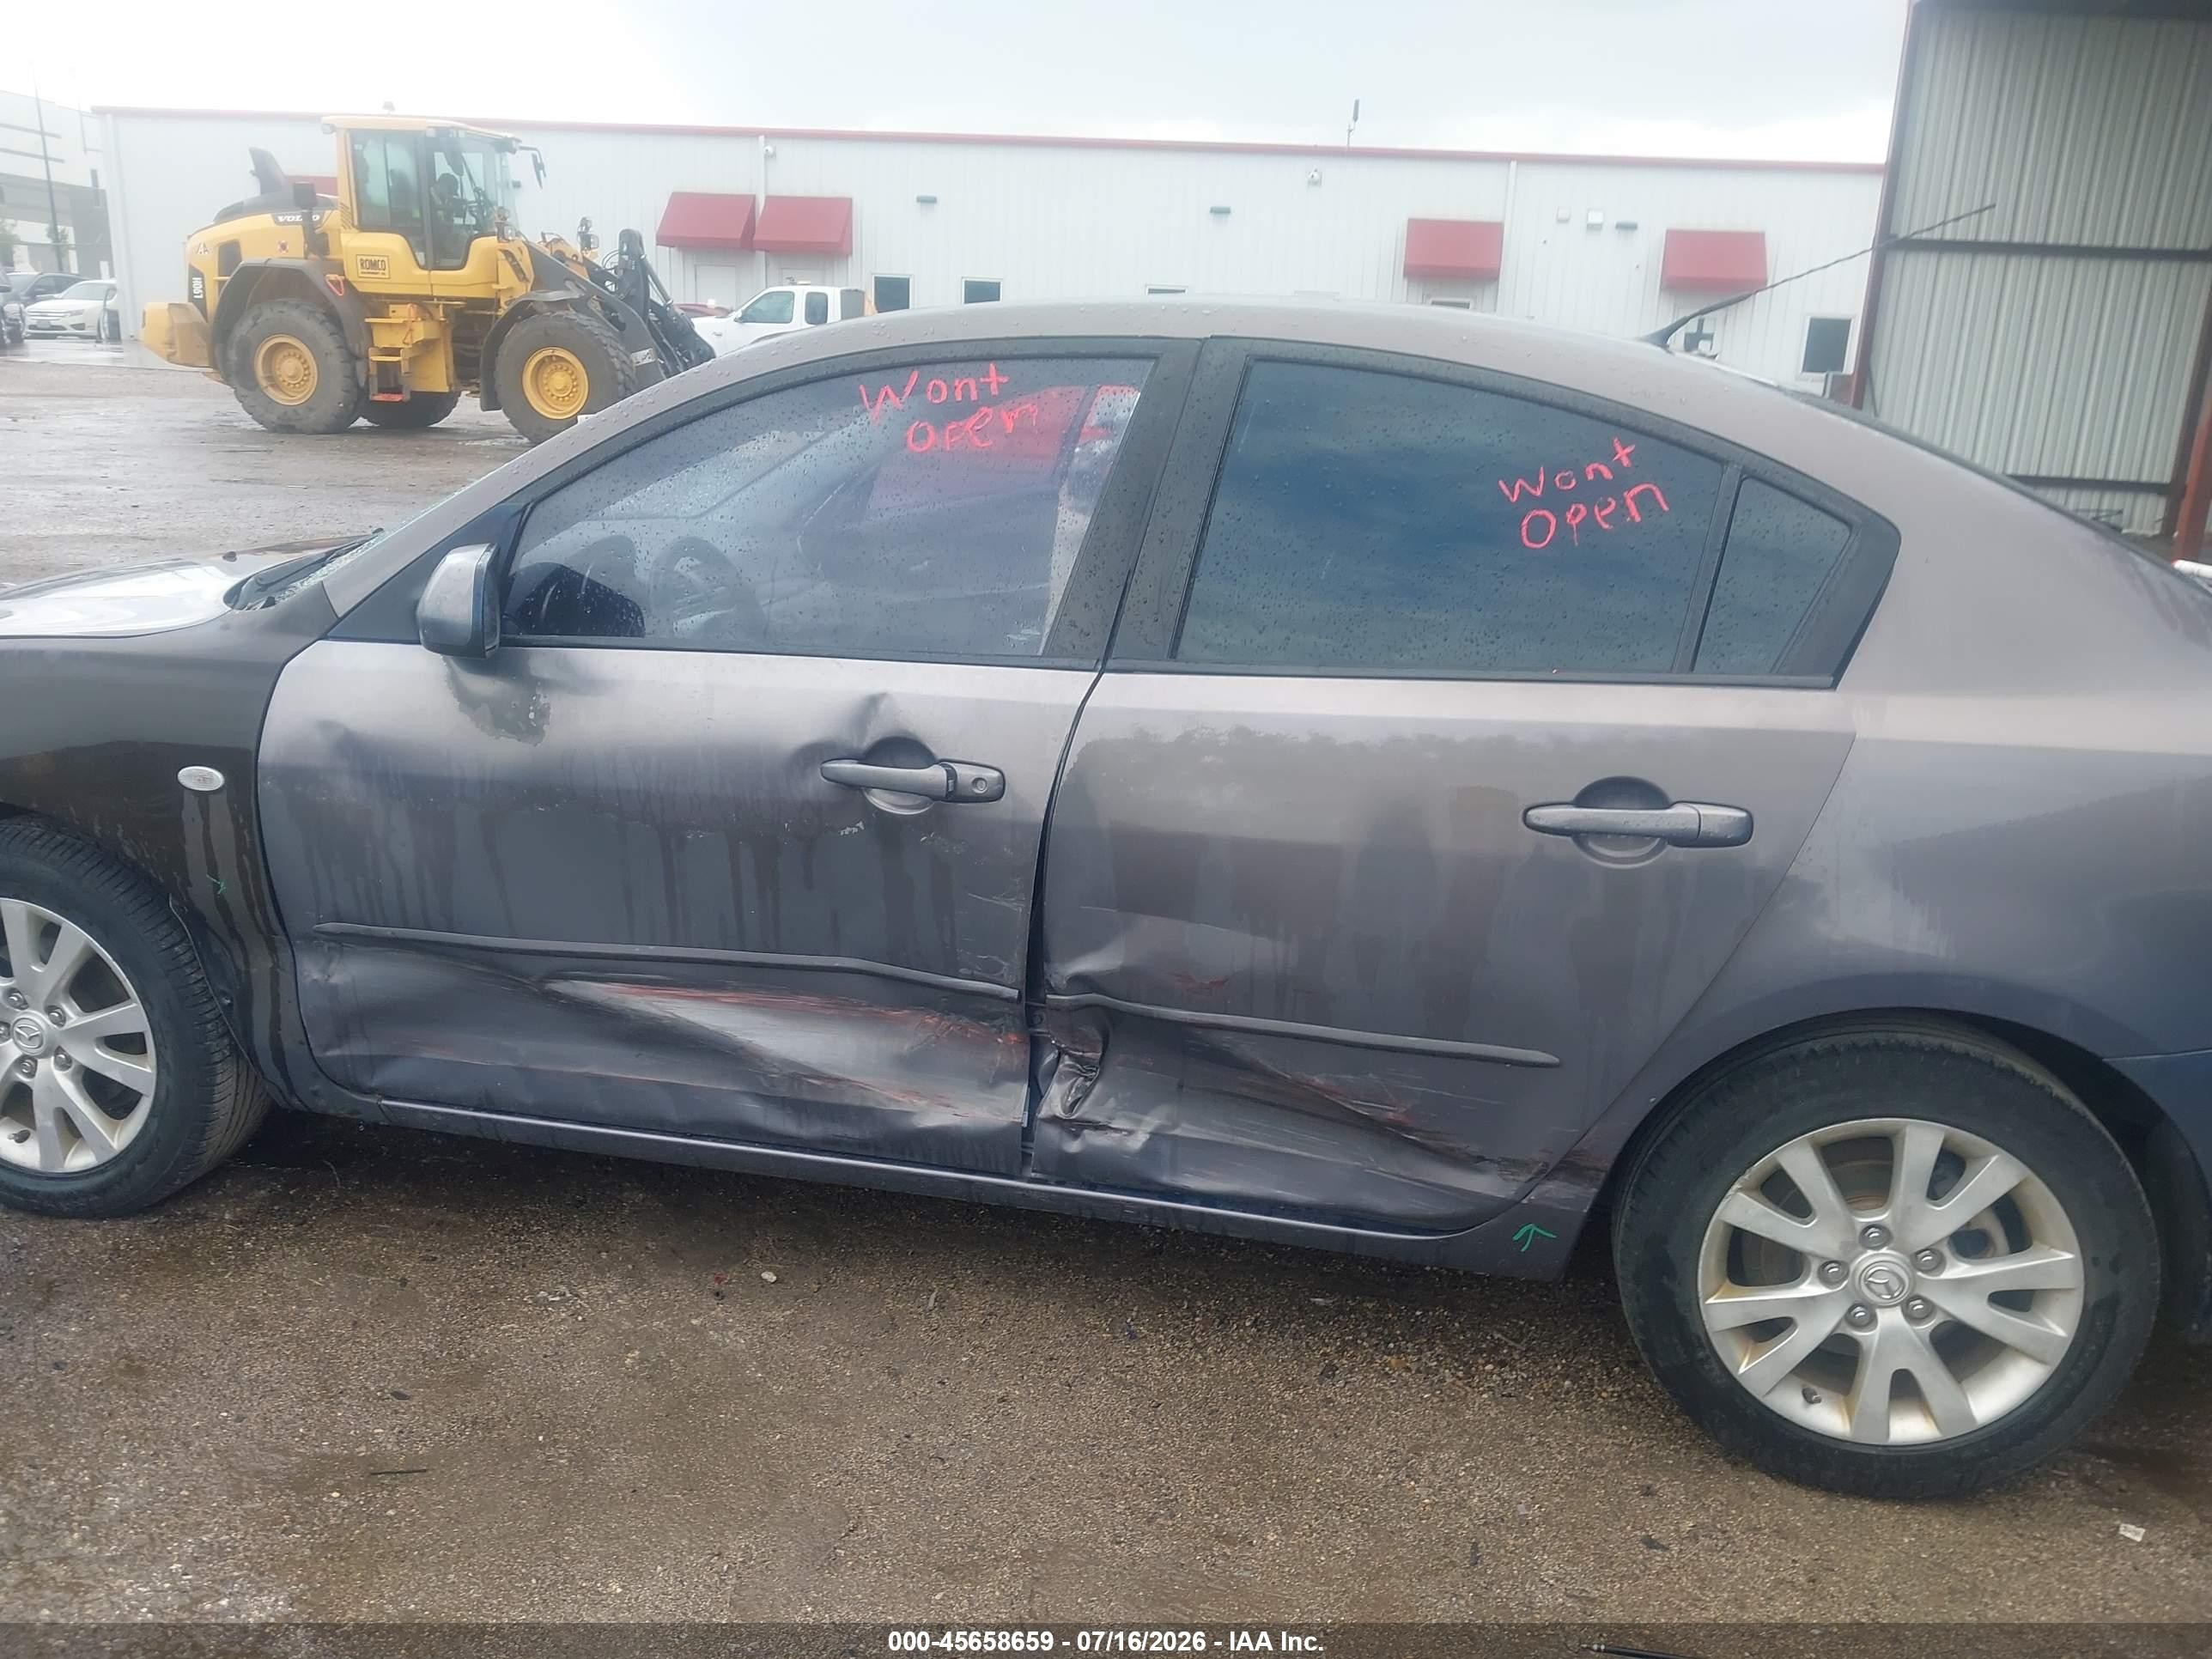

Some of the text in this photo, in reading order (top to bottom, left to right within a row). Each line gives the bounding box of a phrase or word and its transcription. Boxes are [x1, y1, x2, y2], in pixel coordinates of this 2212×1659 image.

[277, 214, 320, 222] VOLO
[360, 258, 386, 271] ROMCO
[191, 276, 204, 299] L90H
[860, 362, 1010, 425] Wont
